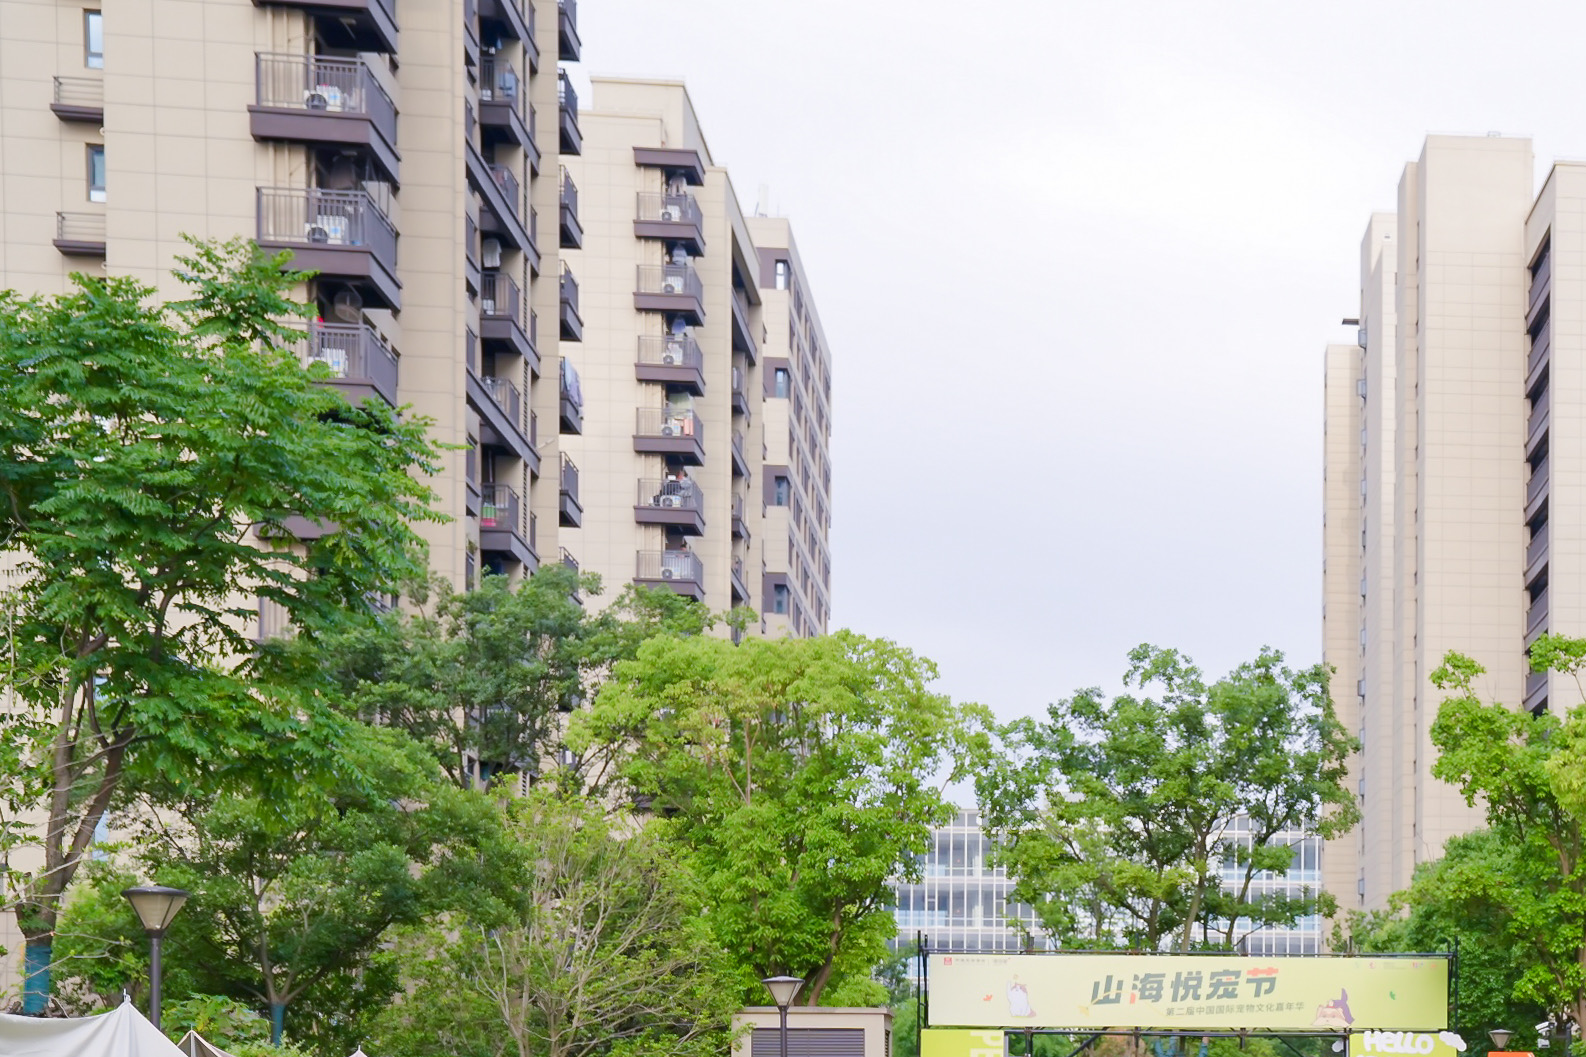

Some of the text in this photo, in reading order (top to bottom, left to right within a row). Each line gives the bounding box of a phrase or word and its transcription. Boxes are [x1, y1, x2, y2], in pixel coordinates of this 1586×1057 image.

[1091, 967, 1279, 1005] 山海悦宠节
[1166, 1002, 1305, 1017] 第二届中国国际宠物文化嘉年华
